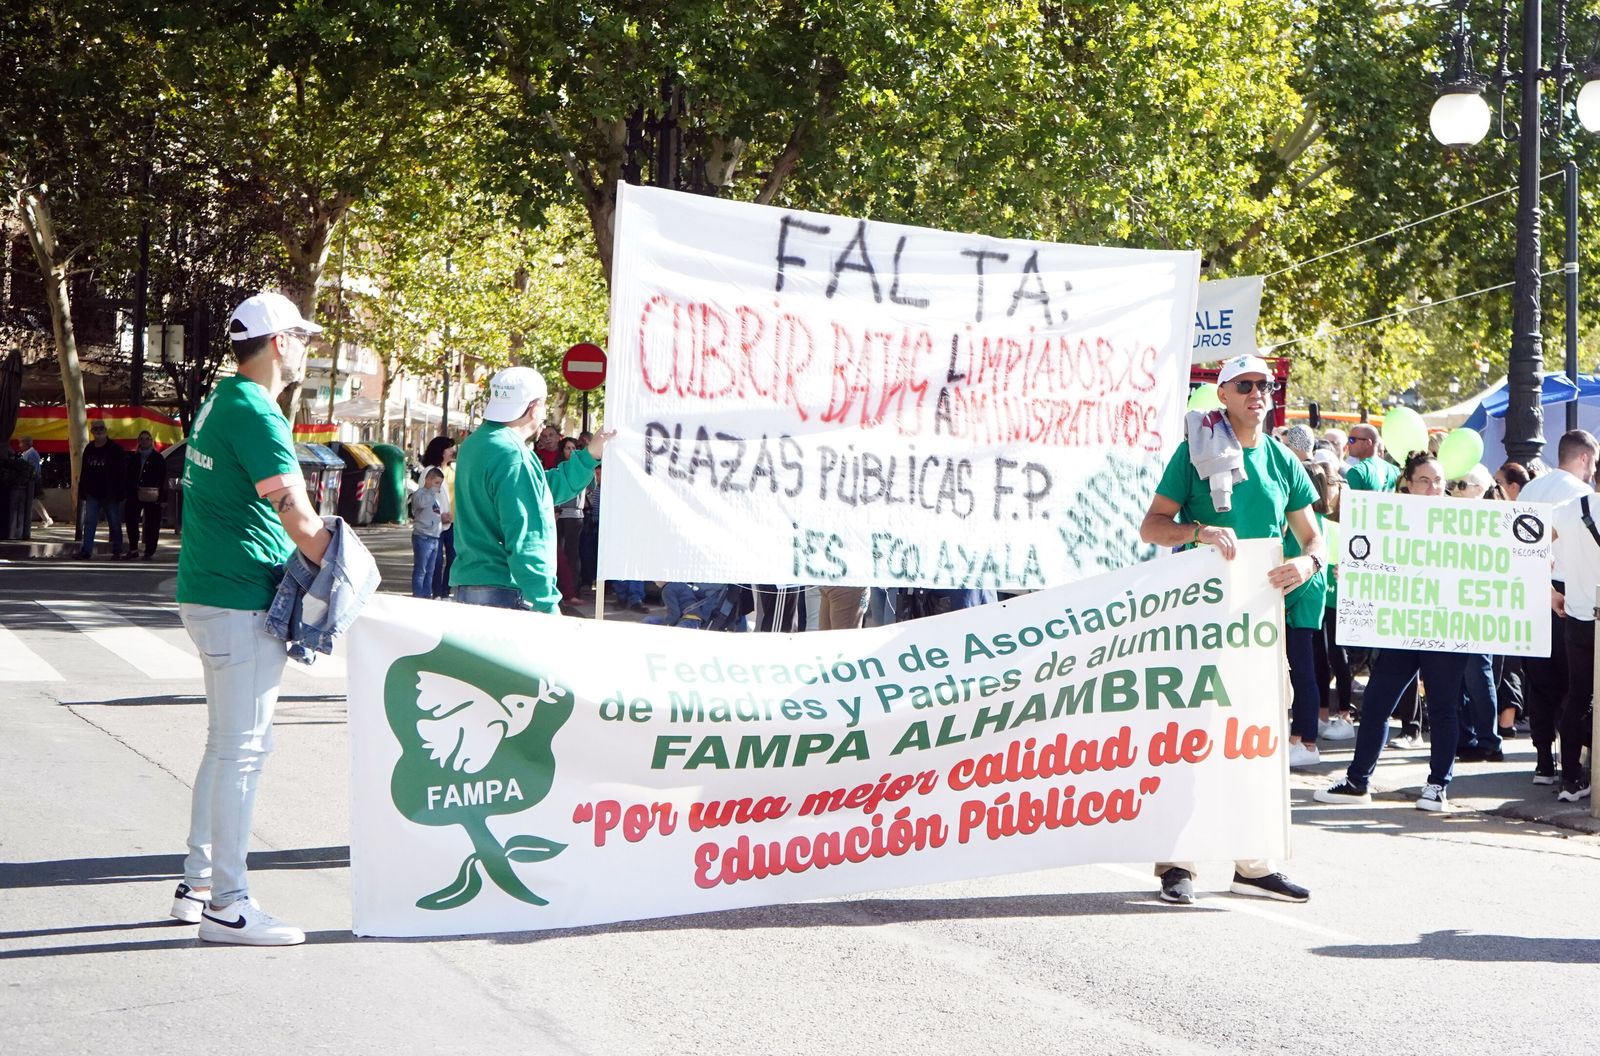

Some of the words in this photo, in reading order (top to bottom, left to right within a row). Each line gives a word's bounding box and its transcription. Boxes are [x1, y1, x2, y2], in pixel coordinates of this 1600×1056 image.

[644, 421, 803, 498] PLAZAS
[993, 457, 1055, 521] F.P.
[1382, 535, 1511, 574] LUCHANDO
[1427, 507, 1502, 538] PROFE
[645, 650, 885, 687] Federación
[899, 642, 950, 674] de
[964, 577, 1225, 664] Asociaciones
[1345, 570, 1441, 605] TAMBIÉN
[1458, 576, 1526, 610] ESTÁ
[1376, 605, 1533, 651] ENSEÑANDO!!
[599, 694, 653, 724] de
[669, 691, 827, 724] Madres
[838, 697, 866, 728] y
[881, 668, 1022, 714] Padres
[1034, 651, 1074, 682] de
[1086, 613, 1278, 669] alumnado
[650, 733, 871, 770] FAMPA
[889, 664, 1232, 756] ALHAMBRA
[427, 778, 525, 811] FAMPA
[688, 792, 792, 833] una
[797, 767, 939, 818] mejor
[947, 725, 1138, 791] calidad
[1147, 721, 1213, 767] de
[1223, 716, 1278, 761] la
[693, 805, 949, 889] Educación
